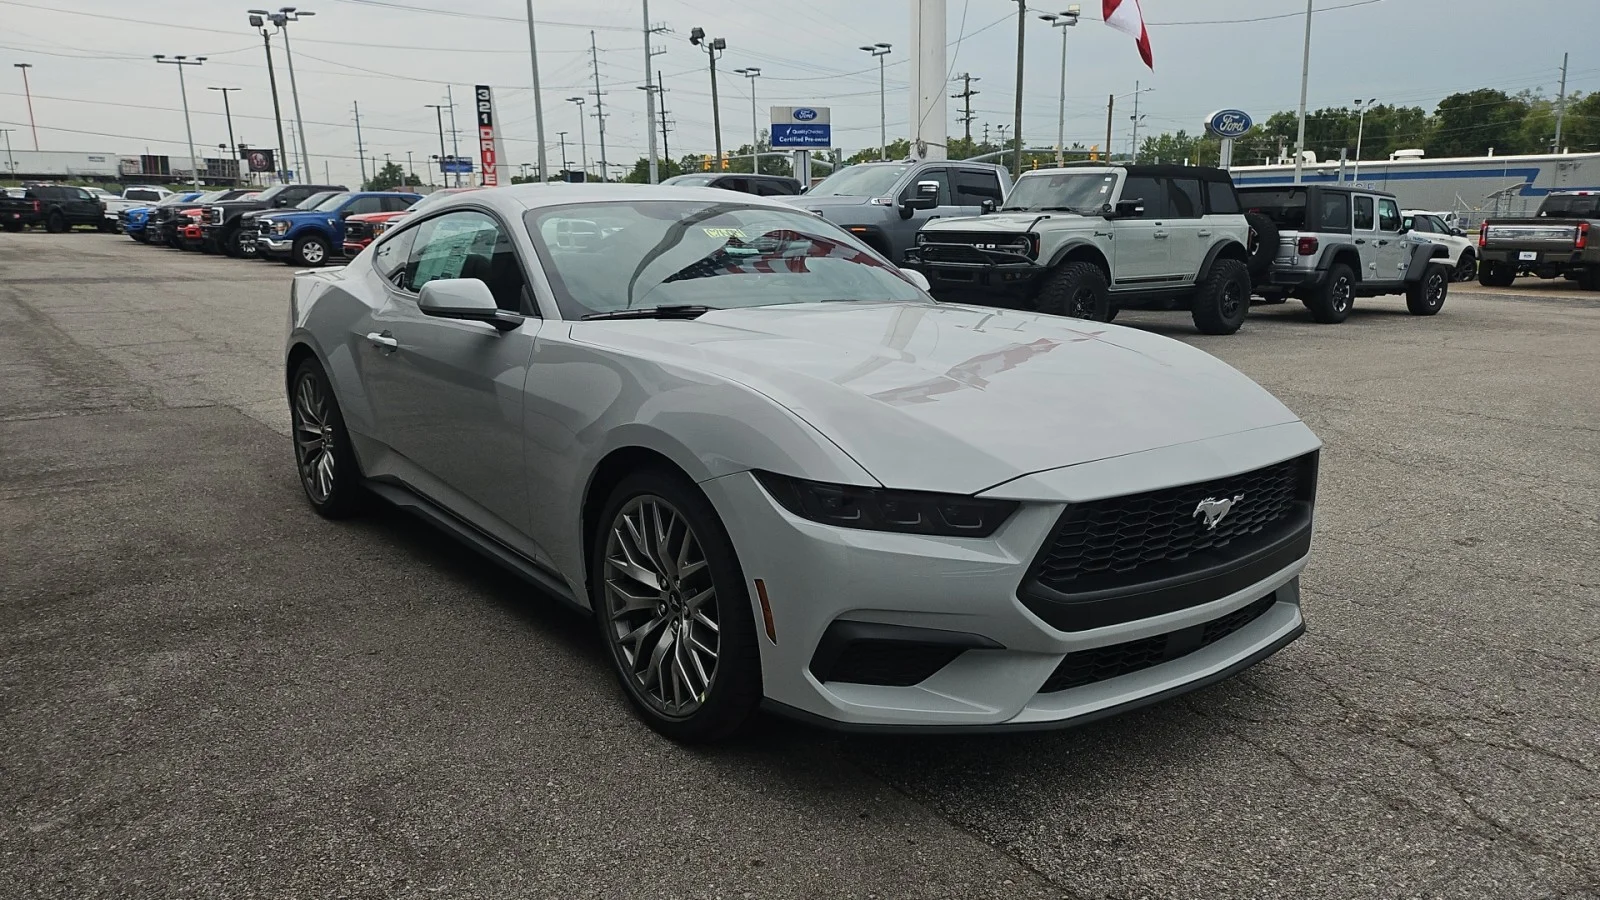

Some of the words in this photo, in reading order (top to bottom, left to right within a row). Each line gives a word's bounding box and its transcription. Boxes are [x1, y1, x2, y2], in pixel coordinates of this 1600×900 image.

[478, 89, 491, 124] 321
[798, 110, 814, 119] Ford
[1219, 114, 1246, 132] Ford
[480, 128, 497, 185] DRIVE
